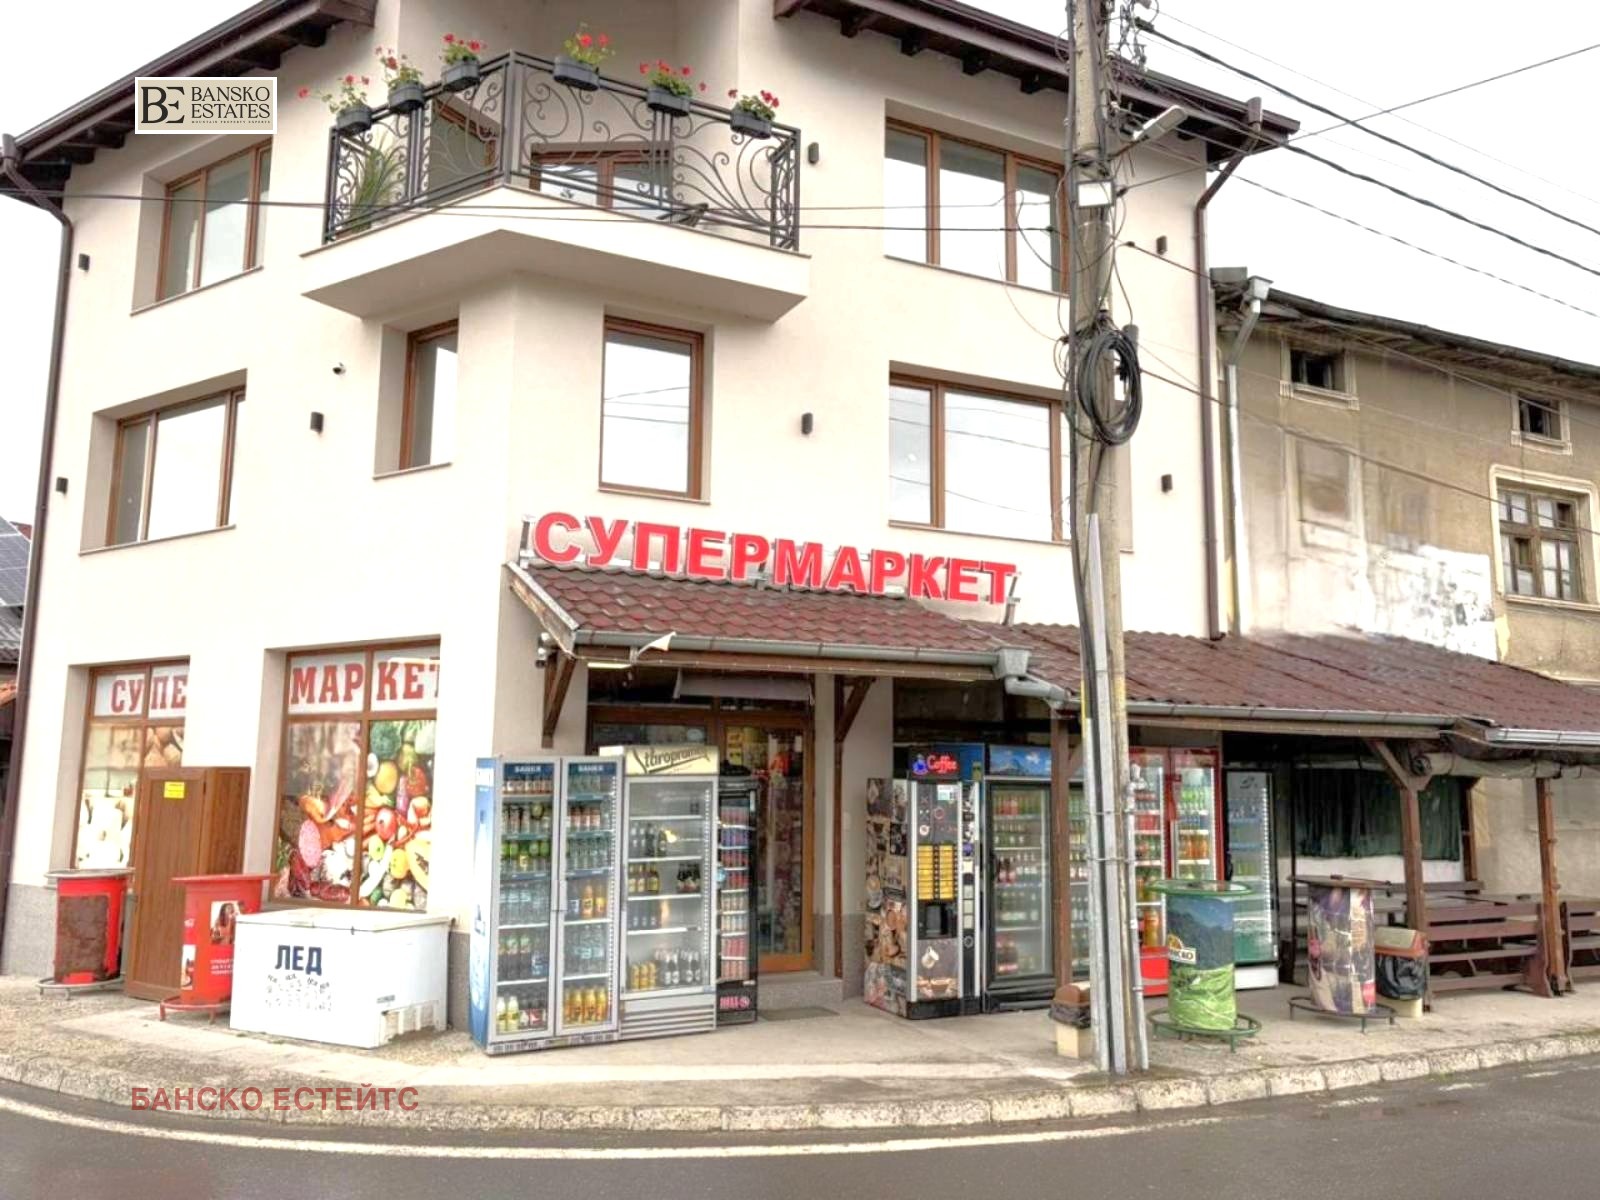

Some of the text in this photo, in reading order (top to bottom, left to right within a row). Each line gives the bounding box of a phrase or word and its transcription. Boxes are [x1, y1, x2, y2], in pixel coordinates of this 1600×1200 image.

[533, 511, 1017, 605] СУПЕРМАРКЕТ
[927, 754, 957, 774] Coffee
[274, 944, 323, 976] ЛЕД
